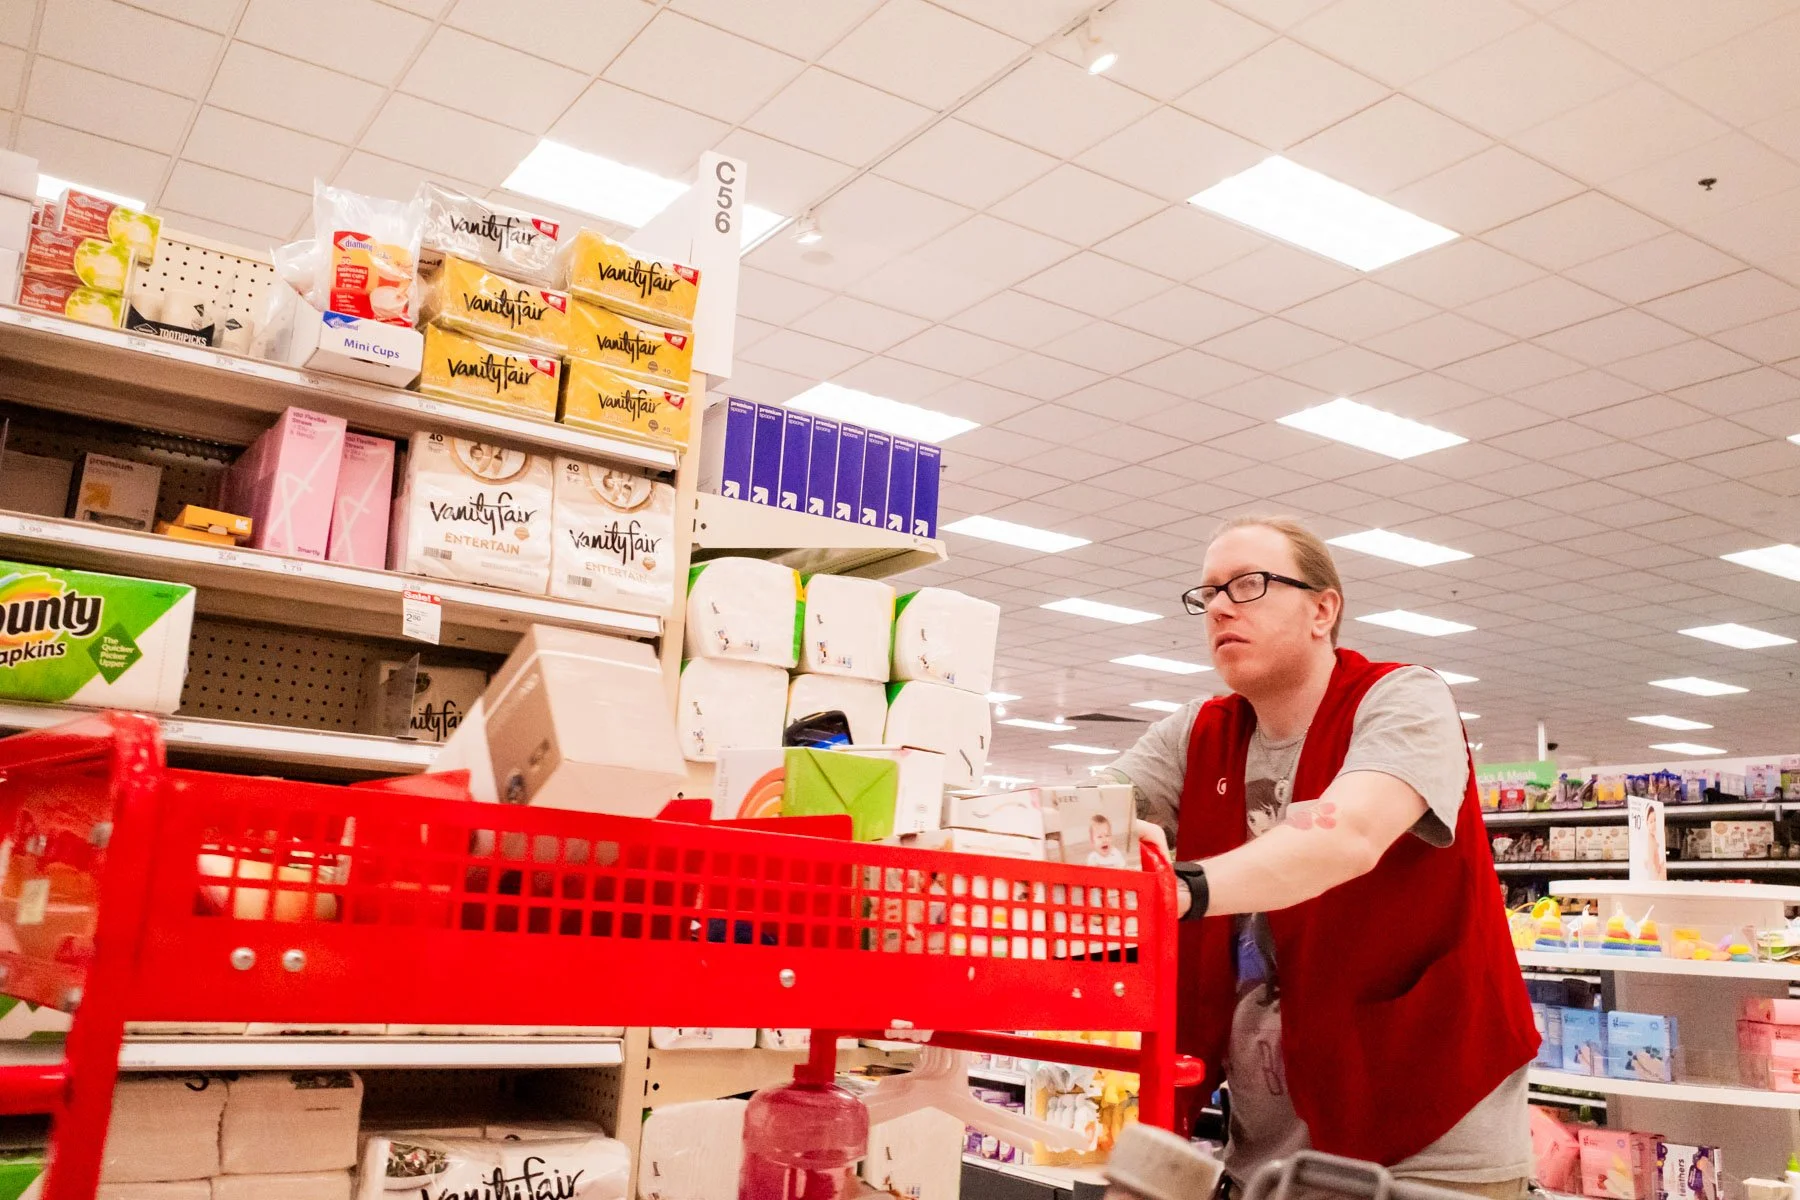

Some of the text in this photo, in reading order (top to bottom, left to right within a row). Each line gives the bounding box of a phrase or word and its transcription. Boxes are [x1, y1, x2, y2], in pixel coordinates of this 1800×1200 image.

[160, 328, 207, 346] TOOTHPICKS
[344, 338, 400, 359] Mini Cups
[730, 401, 753, 410] premium
[760, 407, 782, 416] premium
[788, 413, 810, 423] premium
[816, 420, 837, 429] premium
[429, 433, 444, 442] 40
[89, 458, 133, 472] premium
[567, 463, 579, 473] 40
[444, 532, 520, 556] ENTERTAIN
[585, 562, 648, 583] ENTERTAIN
[103, 636, 119, 645] The
[0, 640, 65, 666] apkins
[101, 643, 134, 654] Quicker
[100, 651, 127, 661] Picker
[99, 658, 125, 668] Upper
